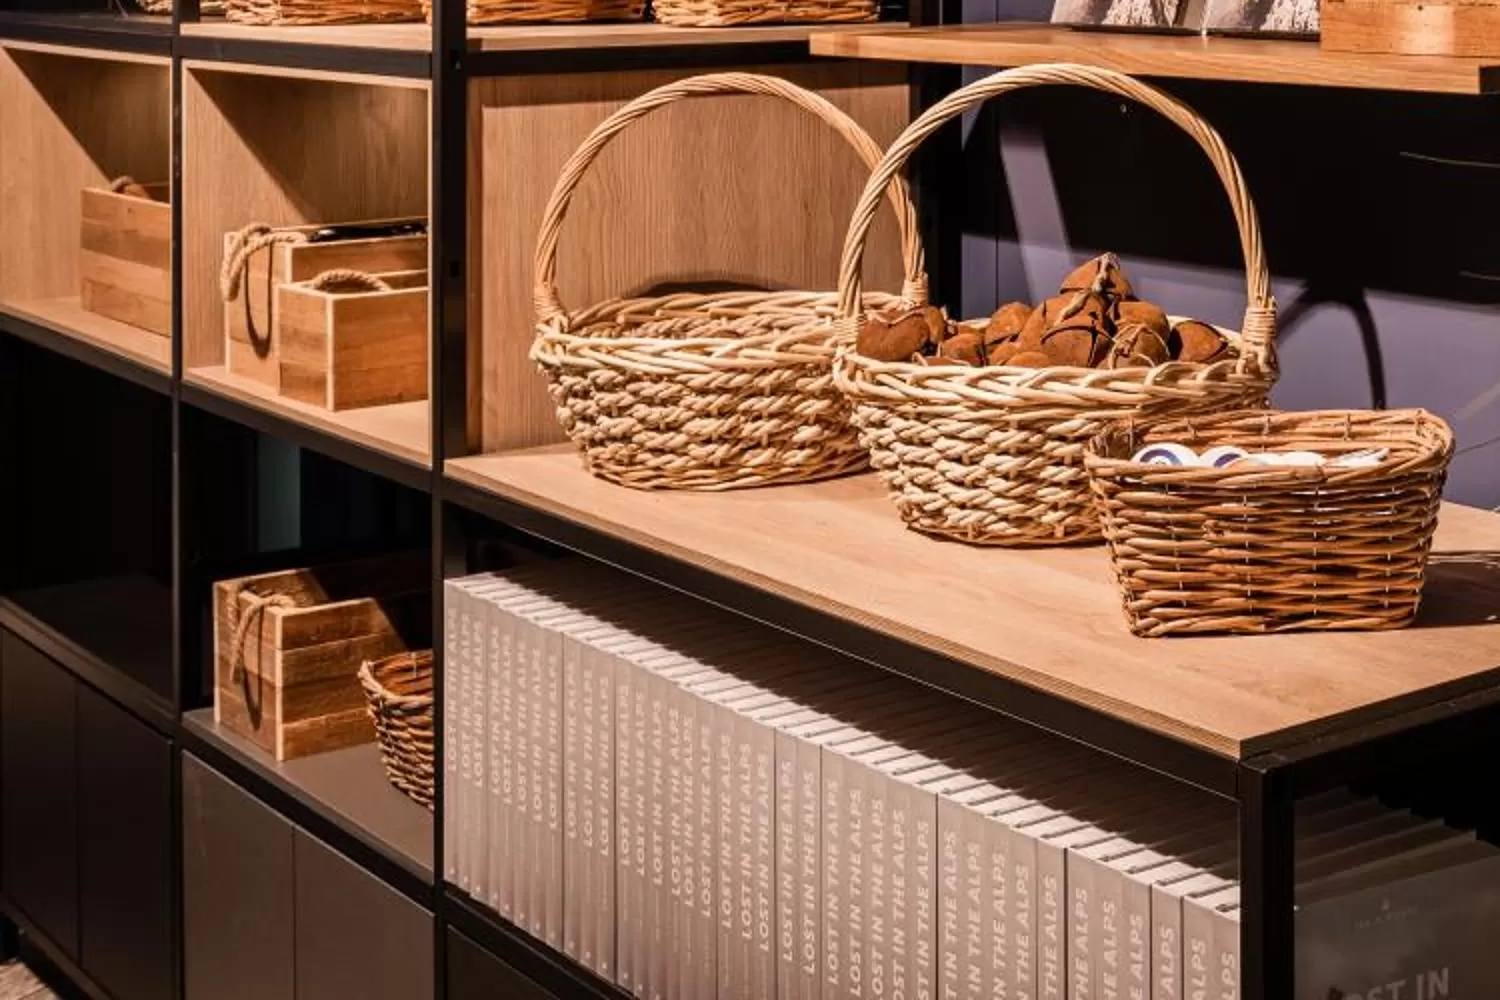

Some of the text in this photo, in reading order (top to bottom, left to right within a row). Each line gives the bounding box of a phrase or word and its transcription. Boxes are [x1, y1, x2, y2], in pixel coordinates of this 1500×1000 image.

[721, 733, 731, 789] ALPS
[701, 724, 711, 916] LOST IN THE ALPS
[721, 791, 731, 835] THE
[740, 742, 752, 939] LOST IN THE ALPS
[721, 840, 731, 866] IN
[758, 752, 769, 951] LOST IN THE ALPS
[782, 759, 793, 962] LOST IN THE ALPS
[803, 768, 815, 974] LOST IN THE ALPS
[827, 778, 838, 984] LOST IN THE ALPS
[944, 831, 957, 891] ALPS
[993, 850, 1007, 916] ALPS
[721, 870, 731, 928] LOST
[850, 788, 861, 997] LOST IN THE ALPS
[872, 798, 883, 1000] OST IN THE ALPS
[893, 808, 904, 1000] OST IN THE ALPS
[918, 818, 928, 1000] ST IN THE ALPS
[945, 896, 957, 944] THE
[968, 843, 981, 993] IN THE ALPS
[1016, 864, 1029, 928] ALPS
[1075, 887, 1089, 954] ALPS
[945, 952, 957, 980] IN
[993, 919, 1006, 969] THE
[1016, 933, 1029, 983] THE
[1044, 876, 1057, 996] THE ALPS
[1103, 900, 1117, 968] ALPS
[1129, 914, 1143, 981] ALPS
[1160, 925, 1175, 996] ALPS
[1221, 952, 1236, 1000] LPS
[1416, 967, 1449, 1000] IN
